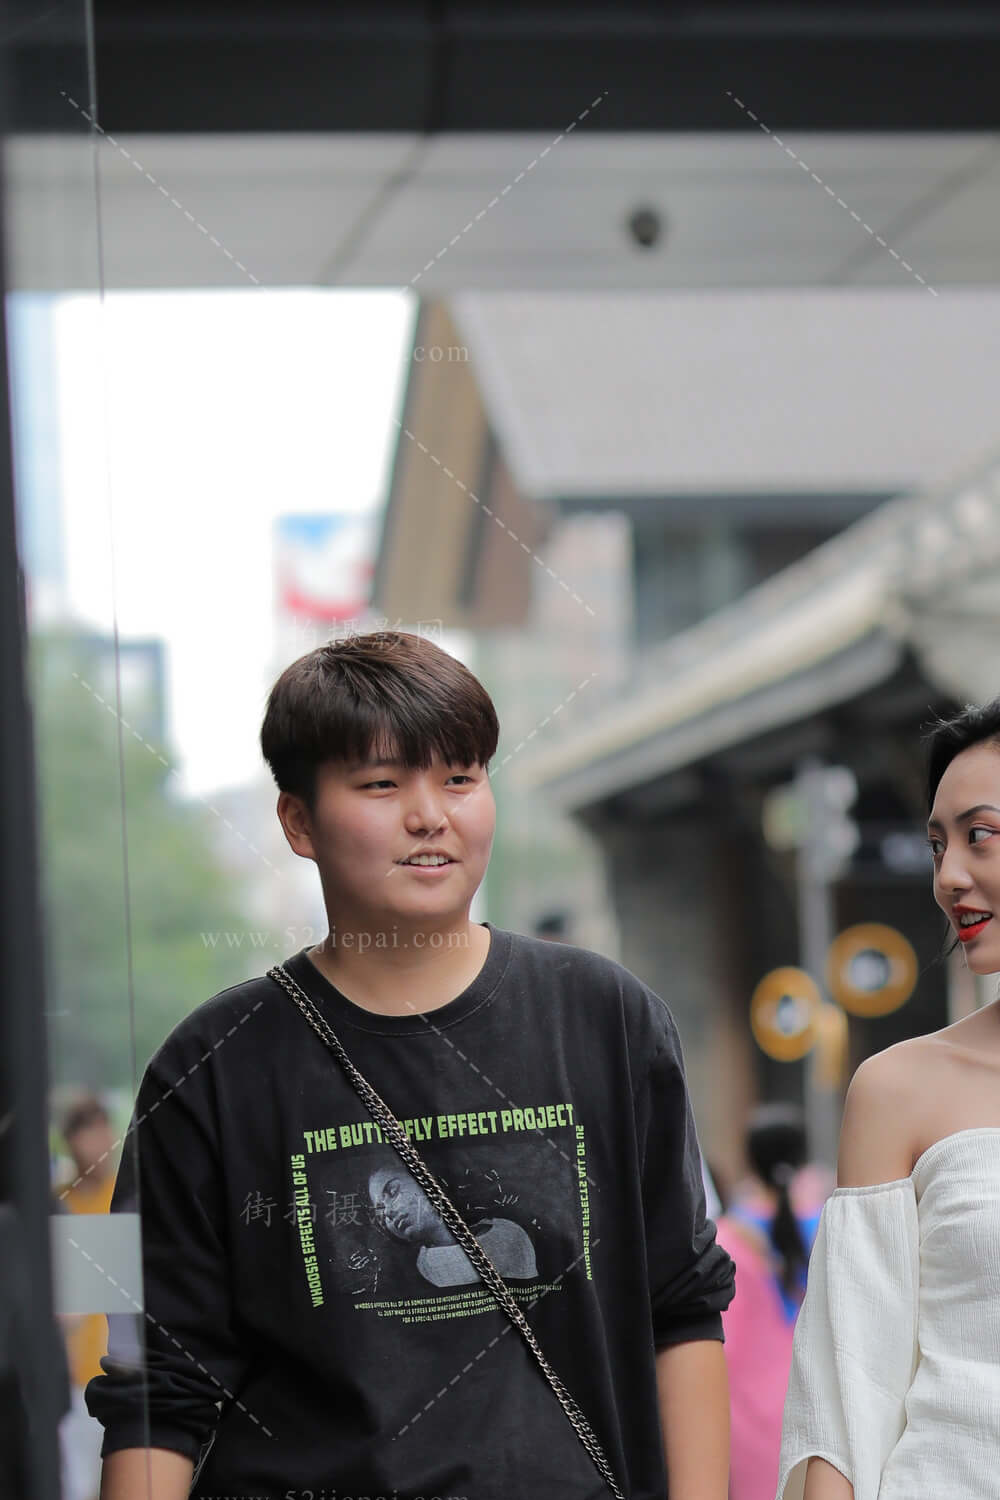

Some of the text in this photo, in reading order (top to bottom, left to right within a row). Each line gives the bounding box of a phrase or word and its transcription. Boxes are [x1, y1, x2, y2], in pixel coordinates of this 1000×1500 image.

[304, 1103, 573, 1154] THE BUTTFLY EFFECT PROJECT
[291, 1154, 324, 1308] WHOOSIS EFFECTS ALL OF US
